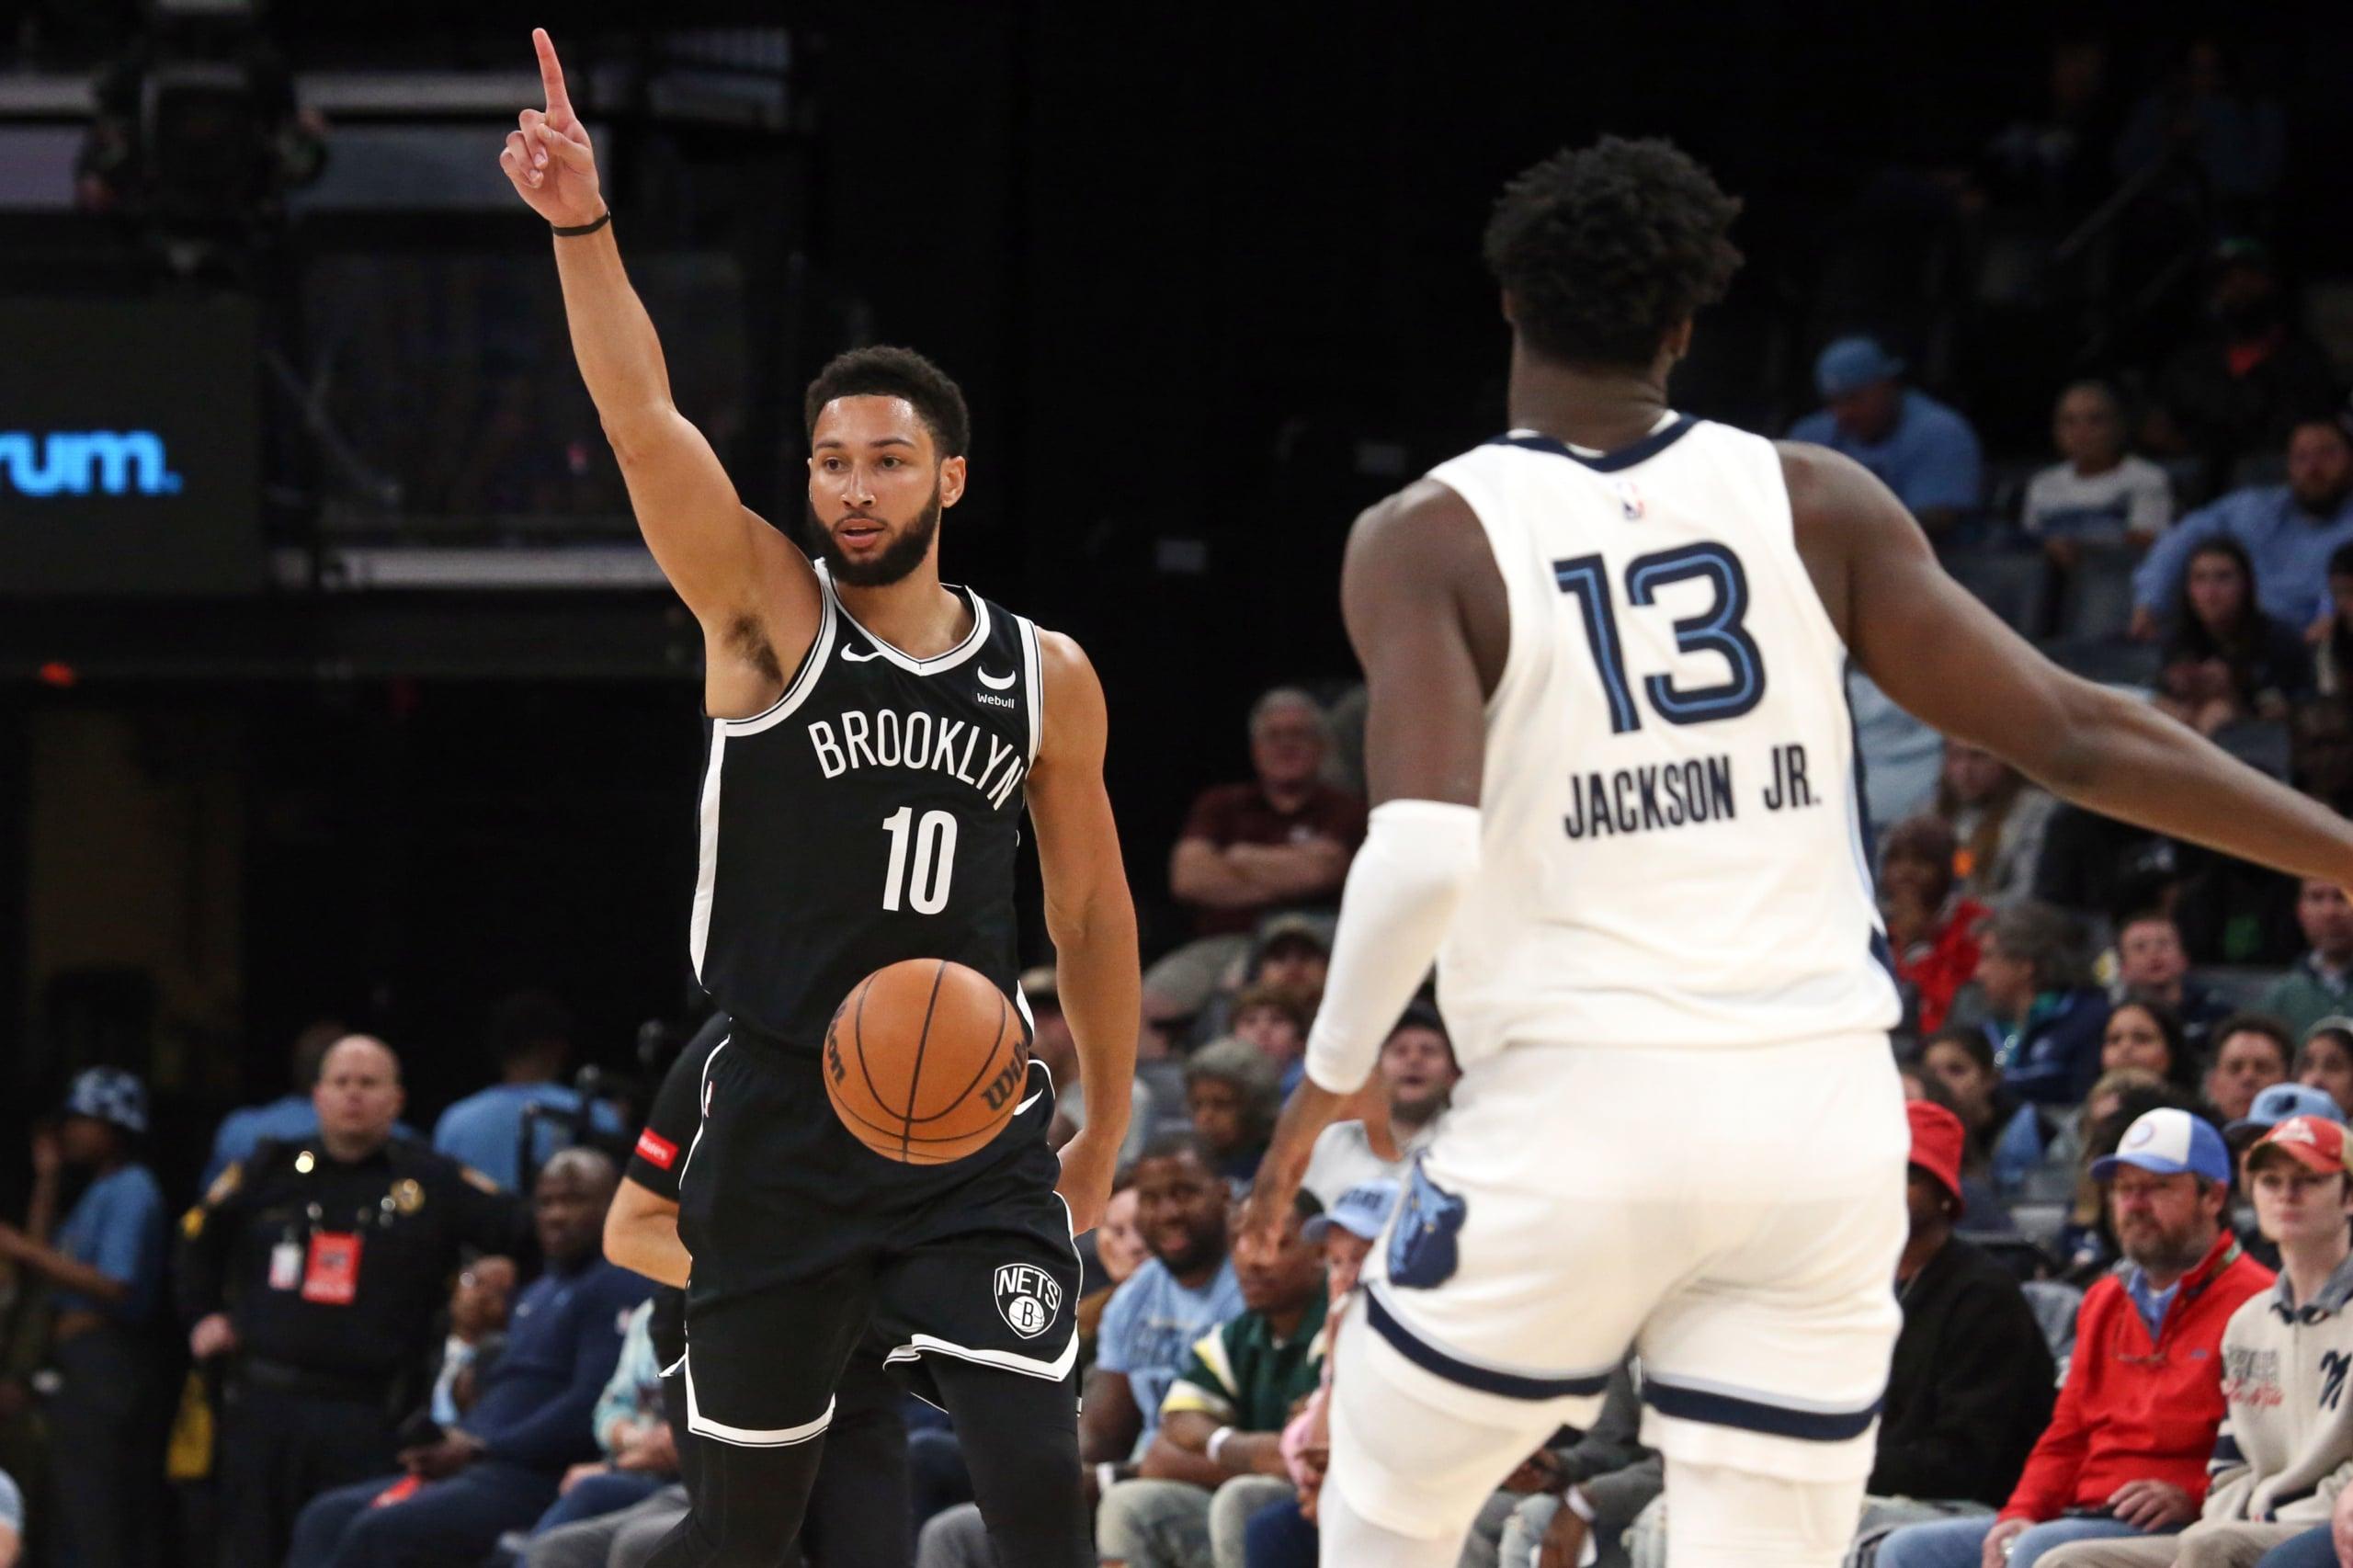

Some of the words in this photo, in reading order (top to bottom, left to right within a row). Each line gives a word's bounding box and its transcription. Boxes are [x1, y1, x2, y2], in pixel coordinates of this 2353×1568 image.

[1552, 540, 1767, 733] 13
[977, 692, 1015, 709] Webull
[808, 709, 1024, 811] BROOKLYN
[1564, 754, 1735, 839] JACKSON
[1763, 743, 1821, 811] JR.
[882, 806, 958, 915] 10
[998, 1267, 1058, 1311] NETS
[1022, 1301, 1034, 1327] B
